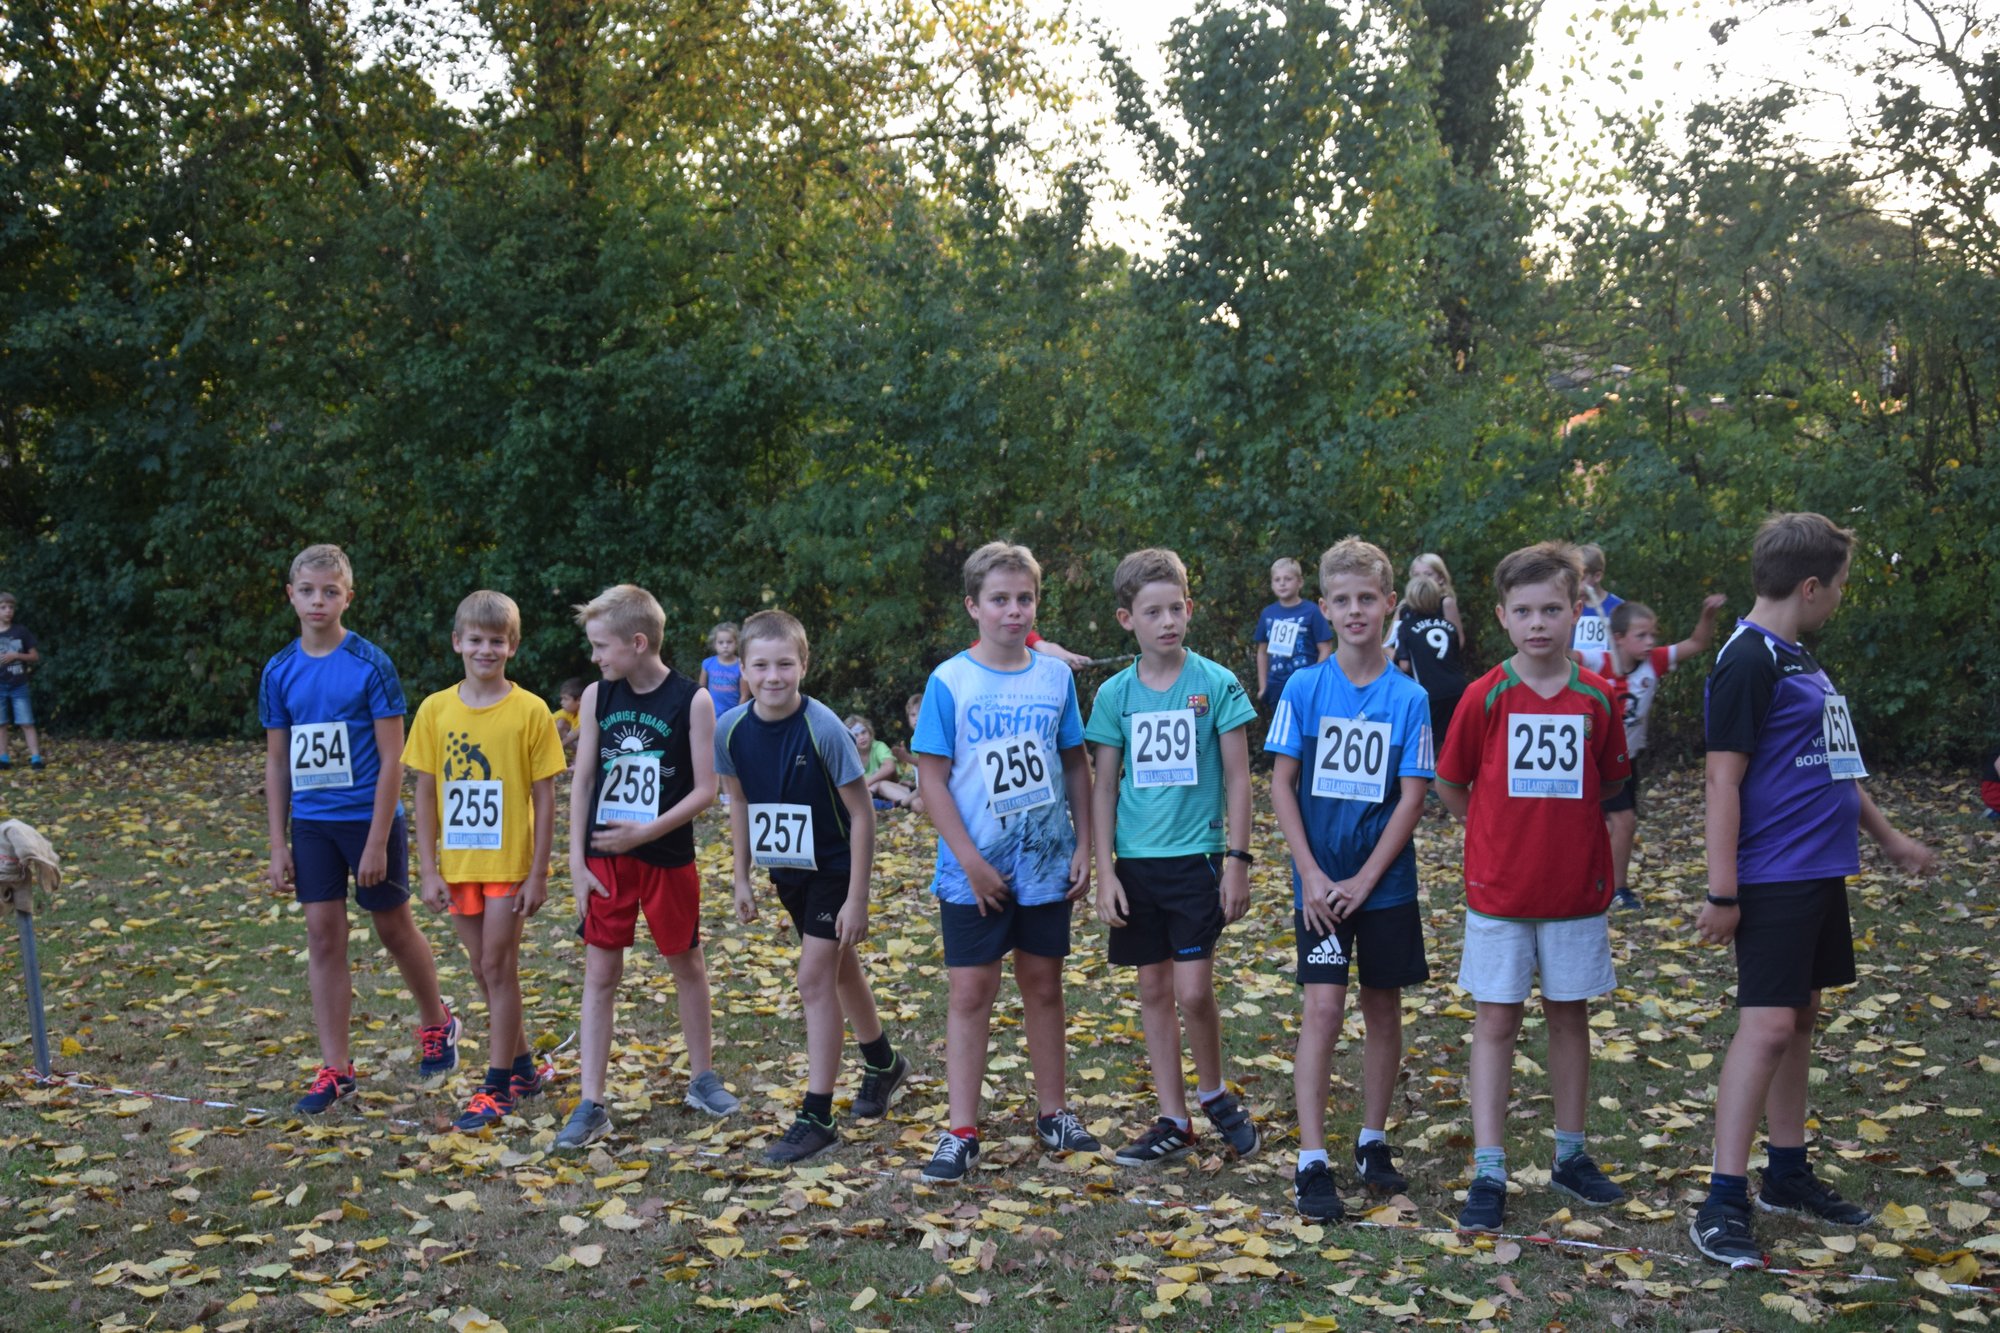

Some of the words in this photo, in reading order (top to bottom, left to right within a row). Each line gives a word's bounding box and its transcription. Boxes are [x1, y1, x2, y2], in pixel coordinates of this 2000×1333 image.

[1273, 623, 1295, 645] 191
[1411, 618, 1454, 634] LUKAKU
[1426, 628, 1449, 659] 9
[1579, 620, 1605, 641] 198
[600, 710, 636, 730] SUNRISE
[639, 712, 673, 737] BOARDS
[967, 703, 1059, 751] Surfing
[1137, 718, 1190, 763] 259
[295, 729, 345, 770] 254
[986, 740, 1044, 794] 256
[1321, 725, 1384, 776] 260
[1514, 723, 1578, 772] 253
[604, 764, 656, 806] 258
[1320, 778, 1332, 791] HET
[1514, 779, 1527, 792] HET
[449, 788, 499, 827] 255
[755, 811, 807, 853] 257
[1307, 953, 1347, 965] adidas
